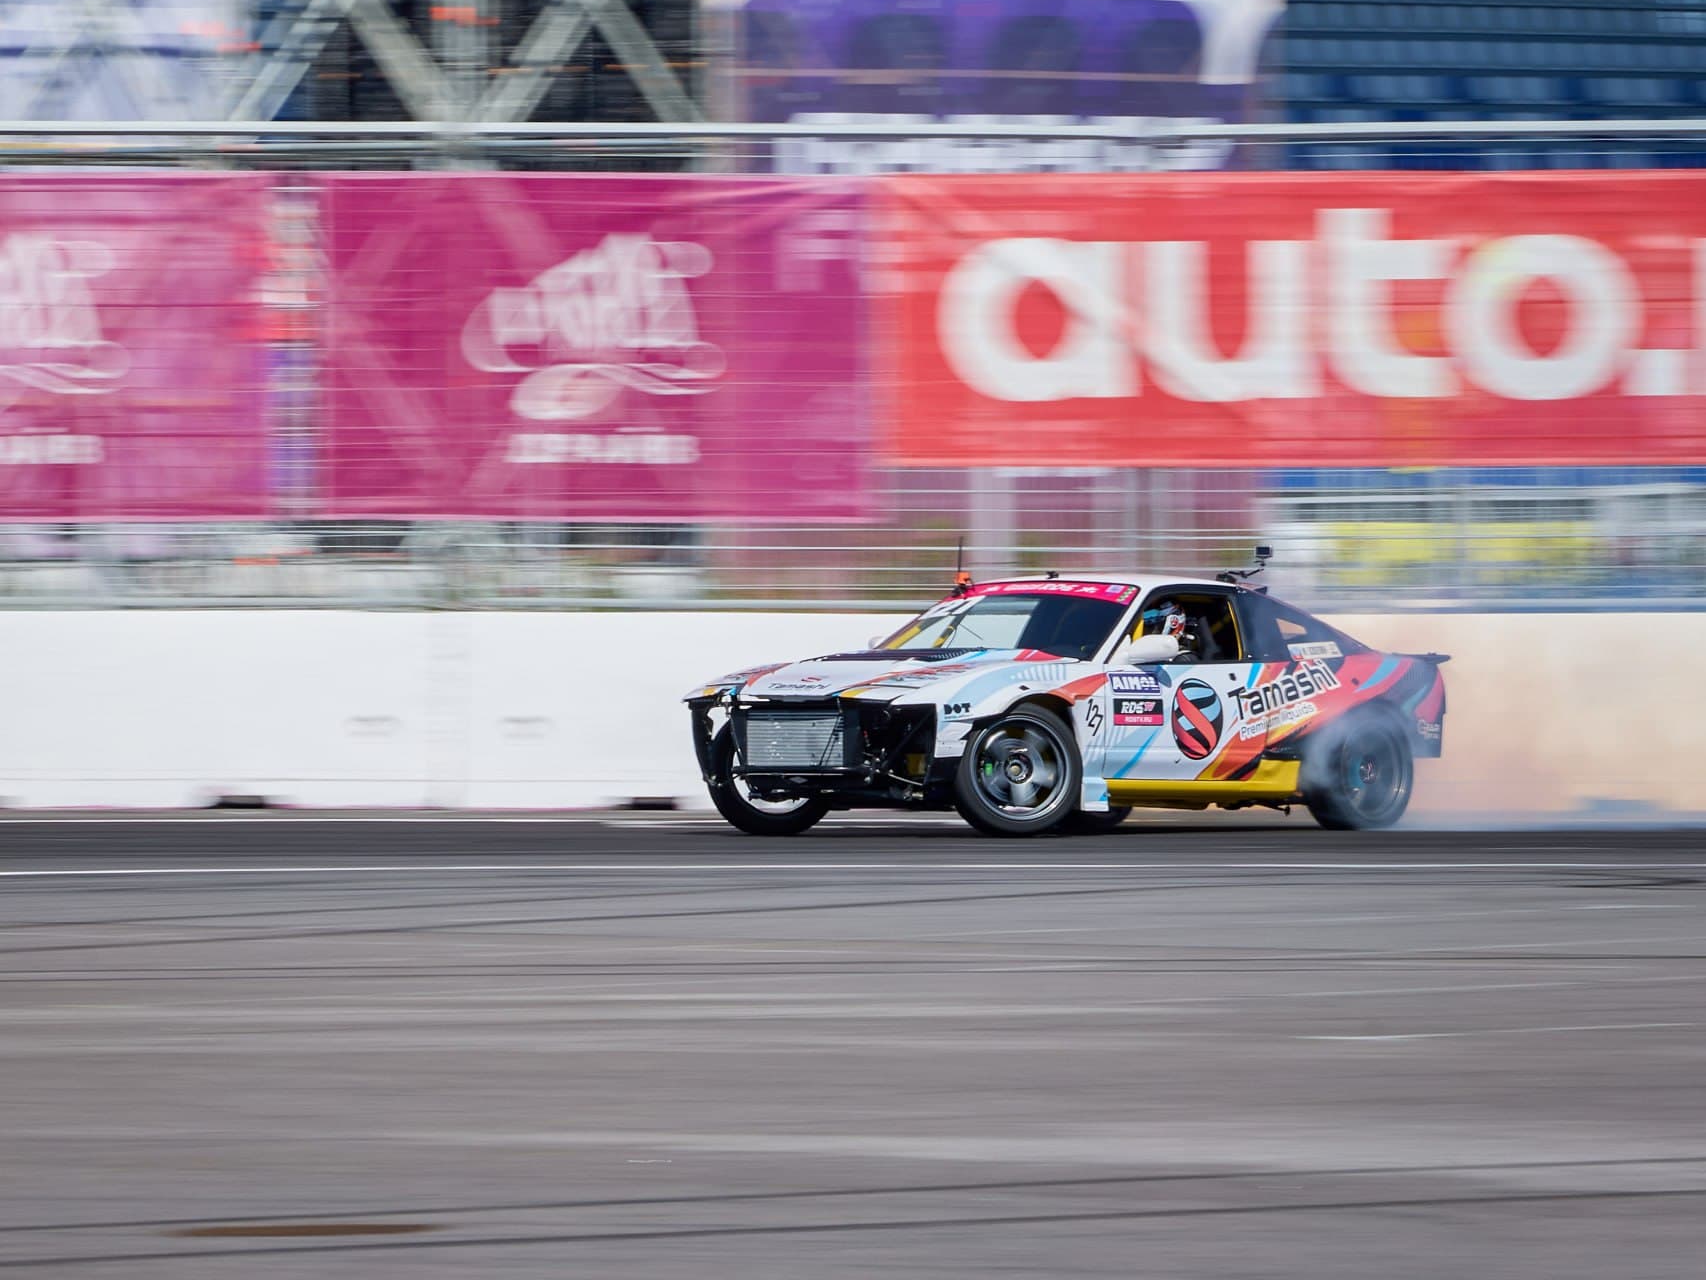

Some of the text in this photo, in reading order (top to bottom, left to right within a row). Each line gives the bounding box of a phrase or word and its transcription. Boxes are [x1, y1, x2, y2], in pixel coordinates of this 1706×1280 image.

[937, 208, 1706, 402] auto.
[943, 702, 971, 715] DOT
[1227, 660, 1338, 720] Tamashi
[1085, 698, 1104, 737] 127
